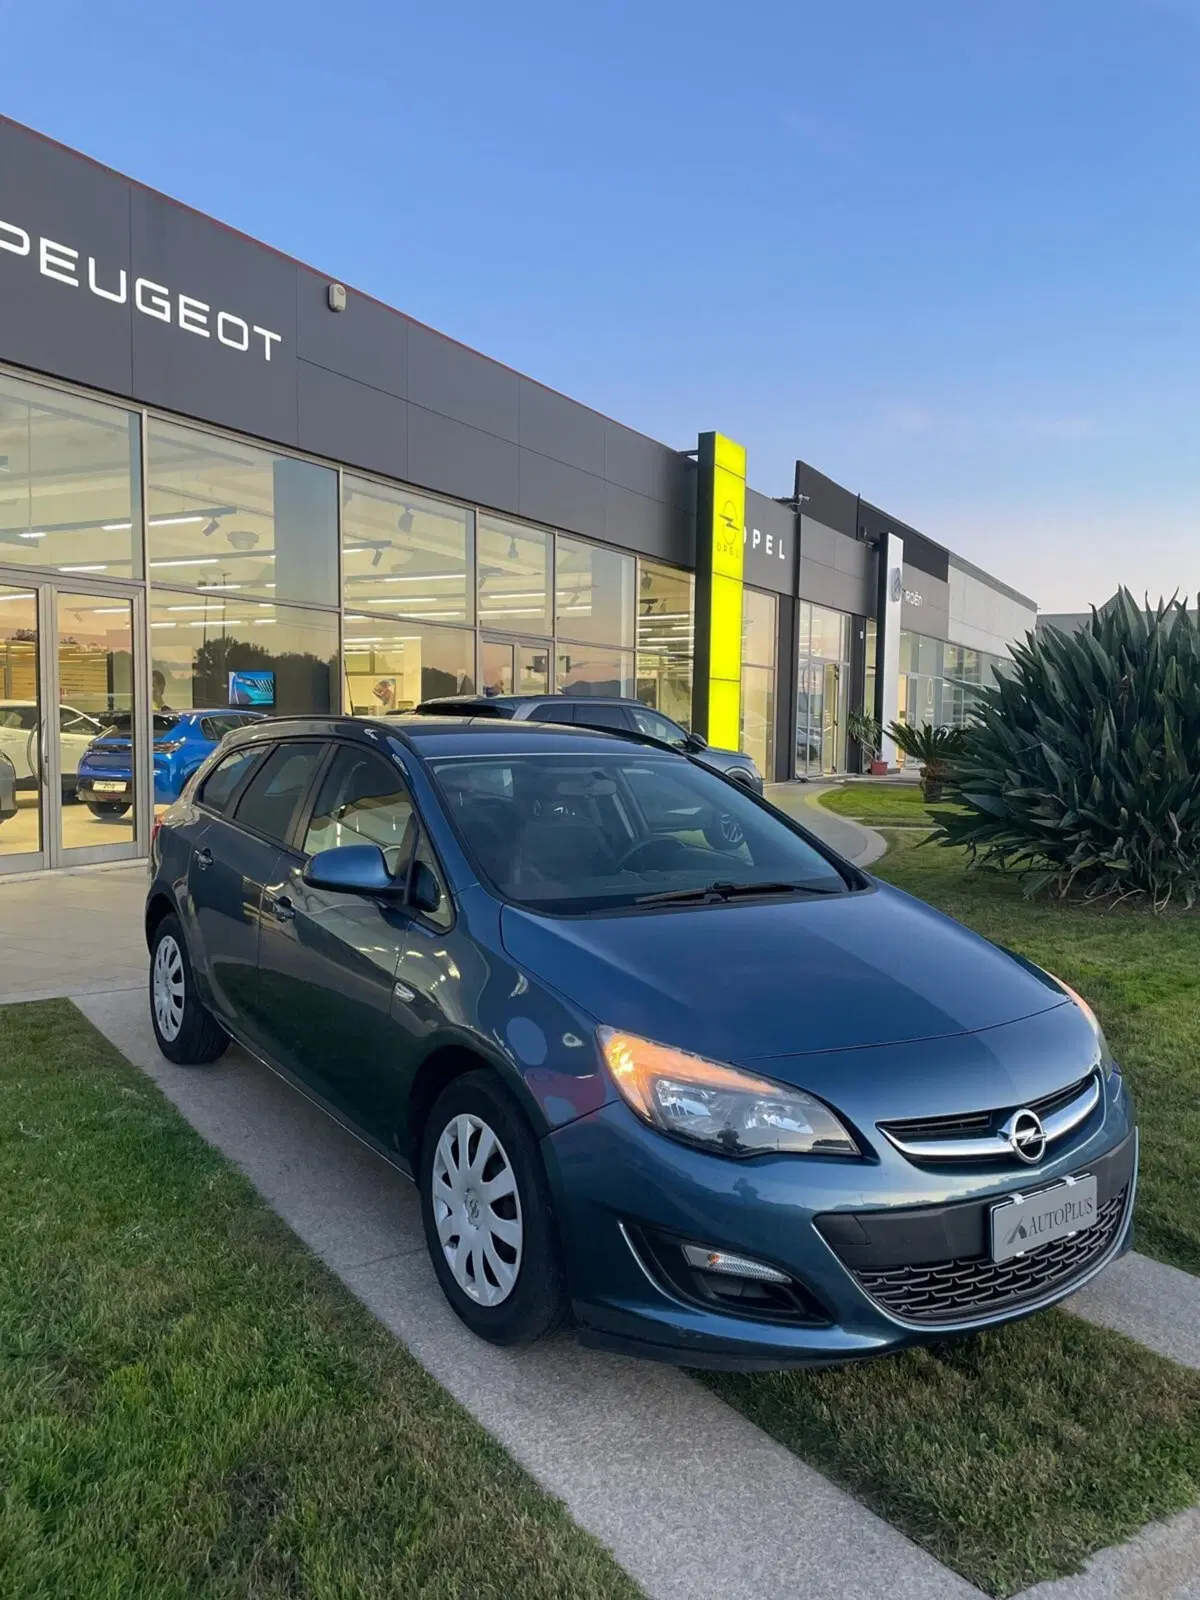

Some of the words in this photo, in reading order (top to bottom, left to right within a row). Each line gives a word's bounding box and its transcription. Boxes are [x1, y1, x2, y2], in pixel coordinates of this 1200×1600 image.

[0, 220, 281, 361] PEUGEOT
[716, 542, 739, 558] OPEL
[743, 526, 785, 559] PEL
